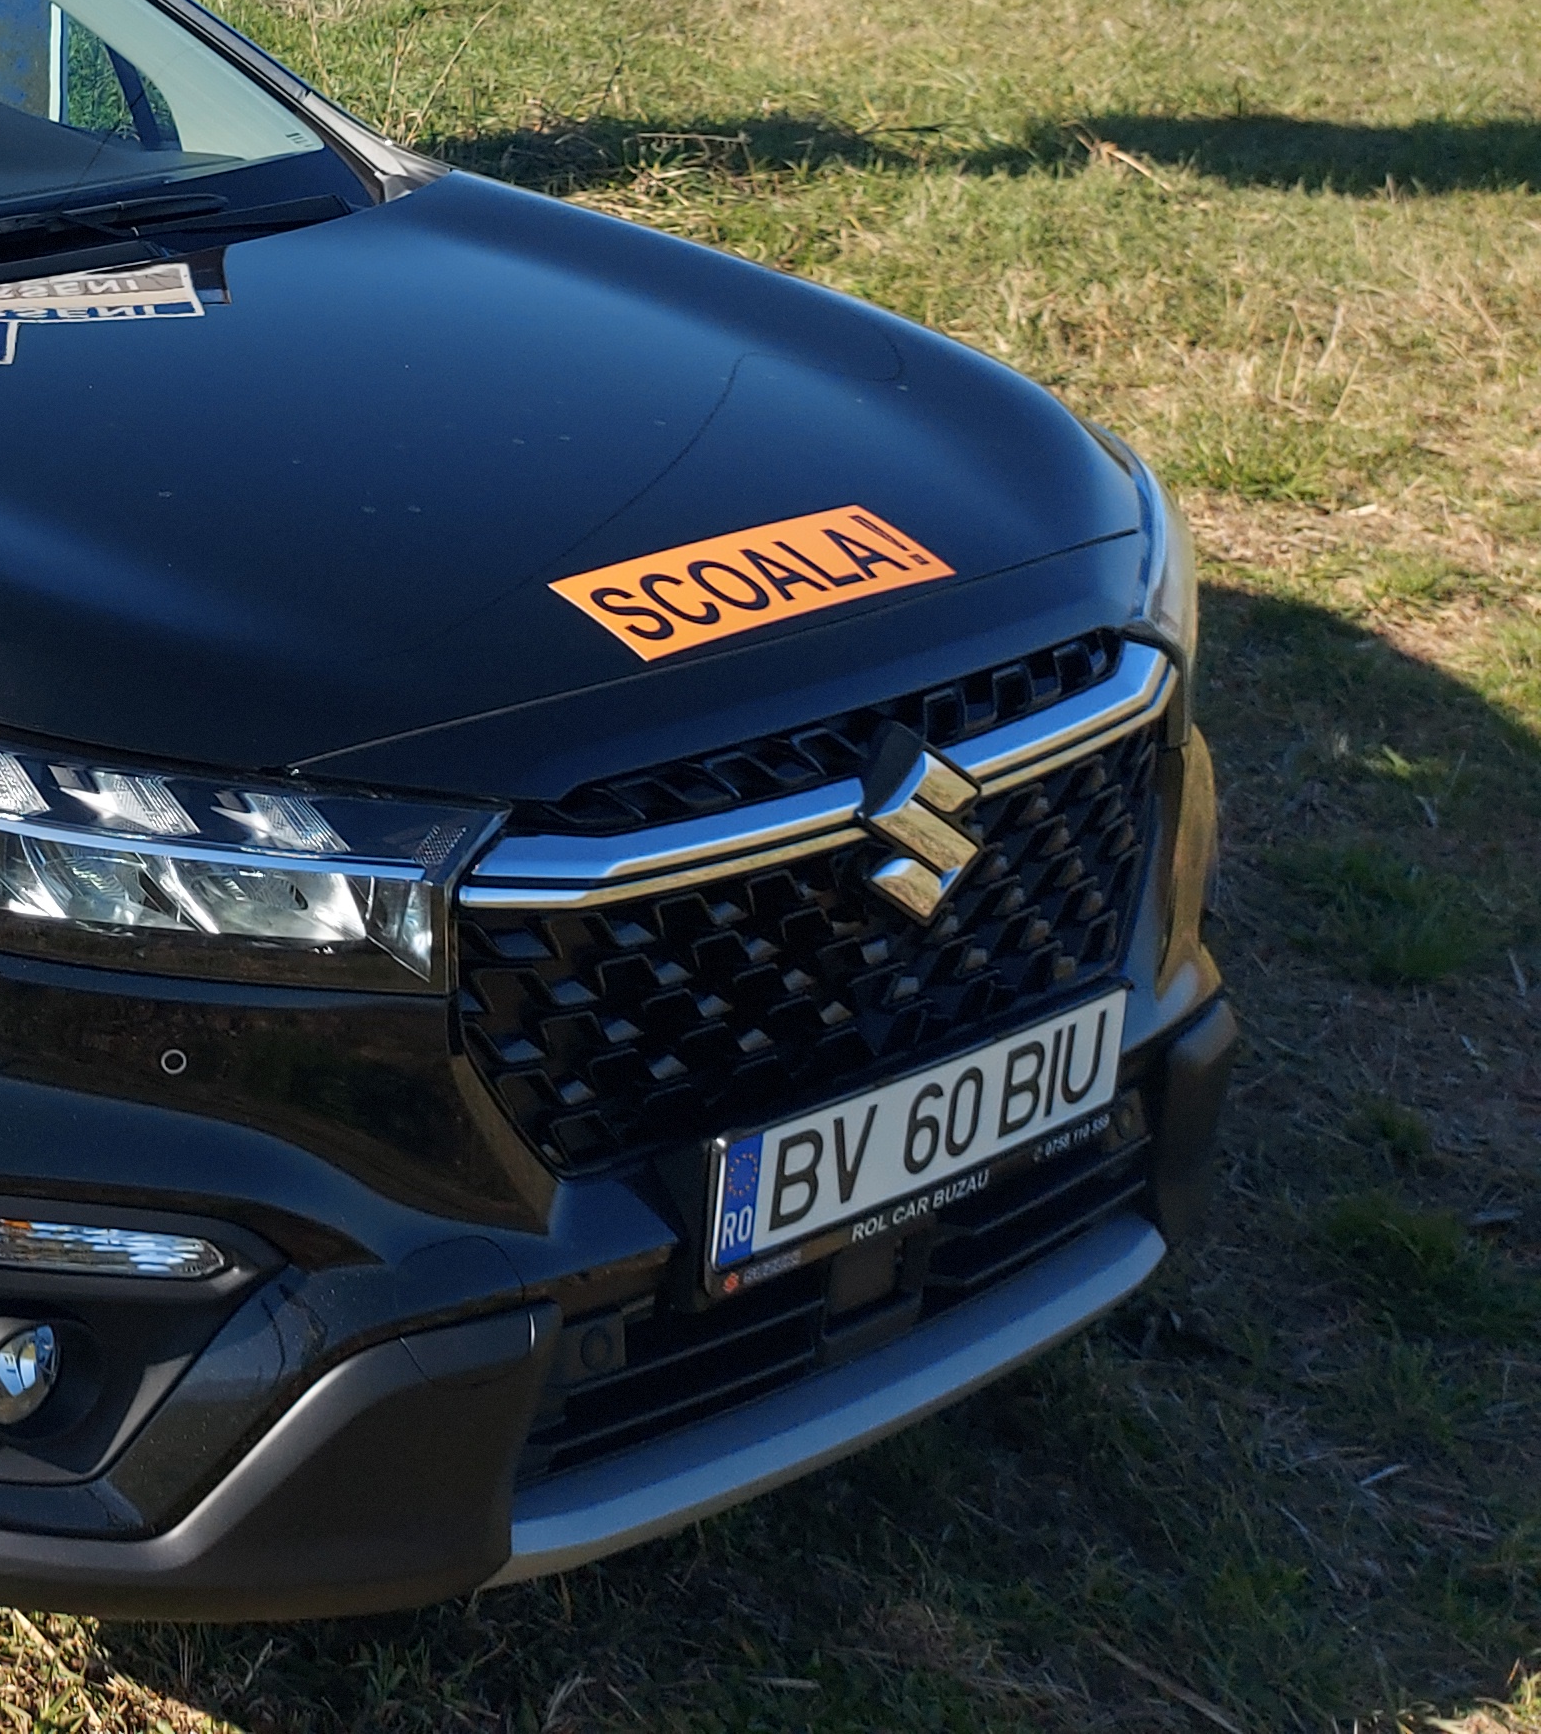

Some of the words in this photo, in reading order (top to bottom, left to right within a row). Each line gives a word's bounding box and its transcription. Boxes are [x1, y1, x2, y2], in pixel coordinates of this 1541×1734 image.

[590, 514, 930, 641] SCOALA!
[720, 1204, 754, 1252] RO
[768, 1103, 878, 1232] BV
[903, 1066, 984, 1175] 60
[998, 1009, 1108, 1139] BIU
[851, 1214, 889, 1243] ROL
[892, 1195, 929, 1225] CAR
[932, 1168, 990, 1210] BUZAU
